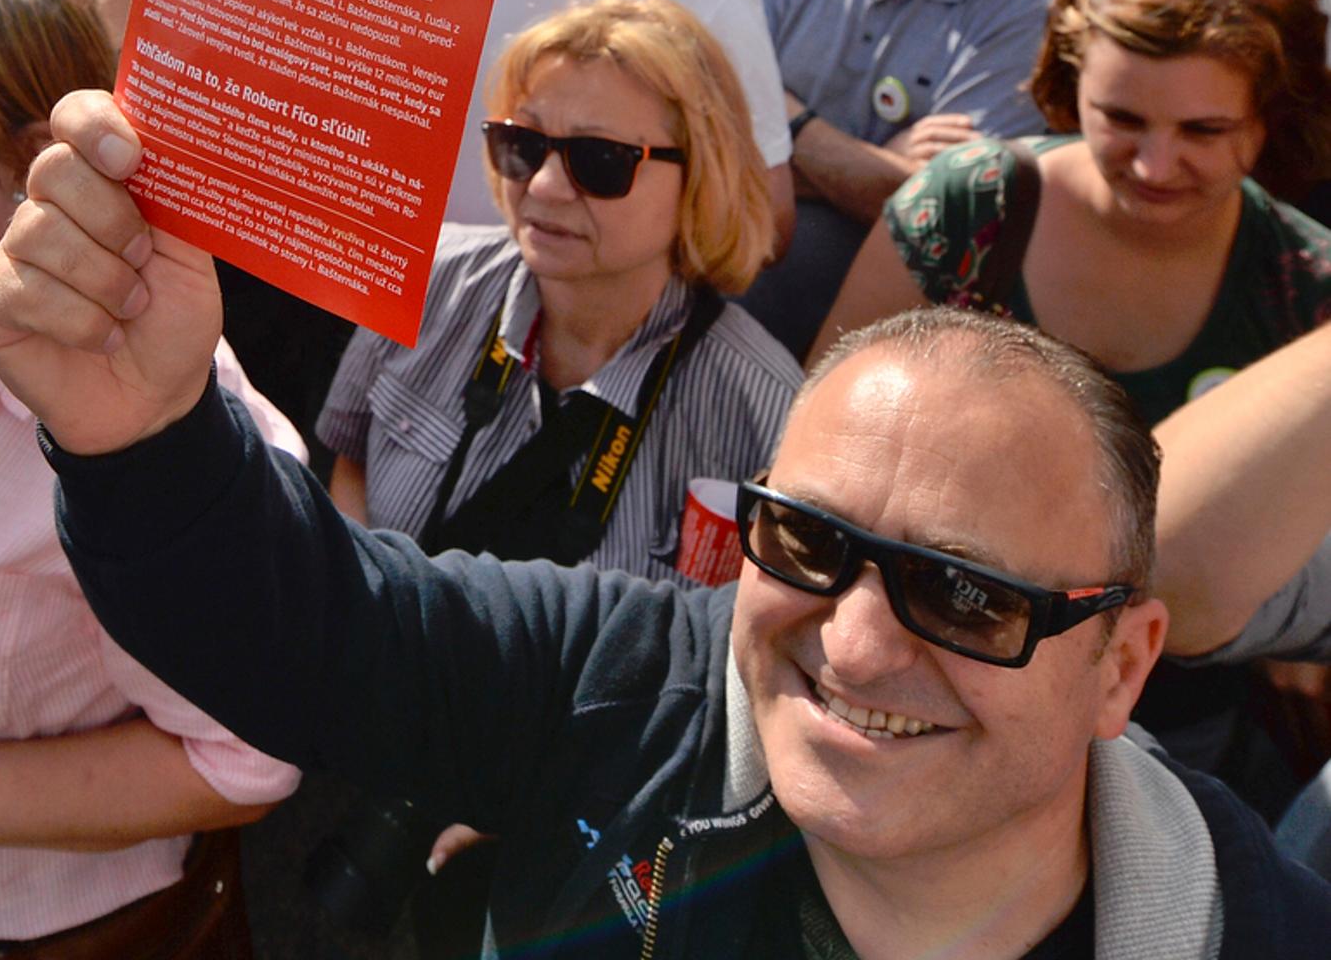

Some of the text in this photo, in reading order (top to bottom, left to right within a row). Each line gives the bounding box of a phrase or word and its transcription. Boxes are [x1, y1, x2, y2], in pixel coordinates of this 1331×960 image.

[187, 64, 203, 84] na
[205, 70, 223, 92] to,
[224, 77, 241, 98] že
[242, 85, 290, 115] Robert
[290, 104, 320, 132] Fico
[321, 116, 372, 148] sľúbil:
[591, 424, 632, 494] Nikon
[686, 818, 711, 834] YOU
[711, 813, 748, 829] WINGS
